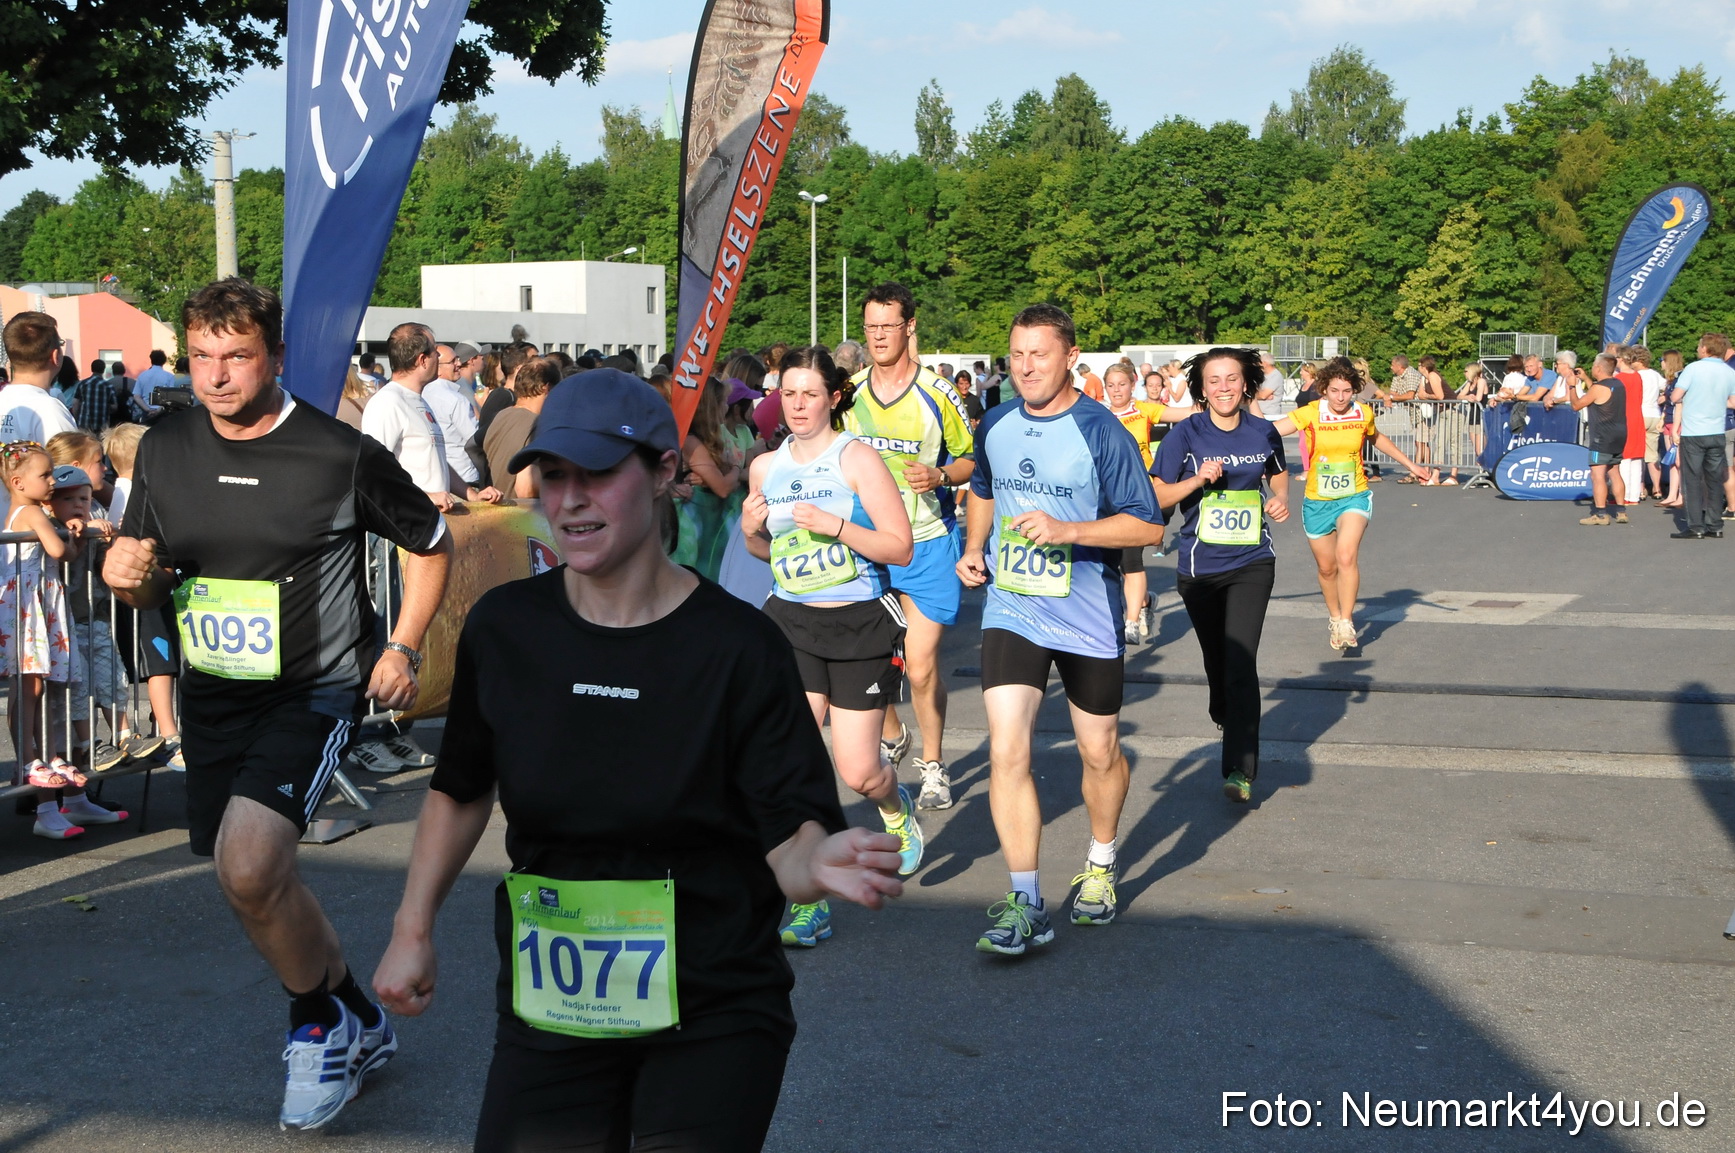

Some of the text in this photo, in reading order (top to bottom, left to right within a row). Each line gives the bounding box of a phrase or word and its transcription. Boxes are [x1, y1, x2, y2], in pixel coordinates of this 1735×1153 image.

[1657, 245, 1676, 268] Druck
[1609, 229, 1680, 321] Frischmann
[1506, 432, 1558, 451] Fisch
[1239, 453, 1267, 465] POLES
[1322, 474, 1350, 490] 765
[1522, 467, 1591, 481] Fischer
[1529, 480, 1587, 488] AUTOMOBILE
[1210, 509, 1252, 530] 360
[775, 542, 846, 580] 1210
[1000, 543, 1067, 578] 1203
[188, 595, 222, 604] irmenlauf
[182, 612, 274, 655] 1093
[233, 664, 256, 672] Stiftung
[572, 683, 640, 699] STANNO
[532, 900, 581, 919] firmenlauf
[583, 915, 616, 927] 2014
[518, 930, 666, 1000] 1077
[562, 999, 622, 1013] Nadja Federer
[546, 1009, 641, 1027] Regens Wagner Stiftung
